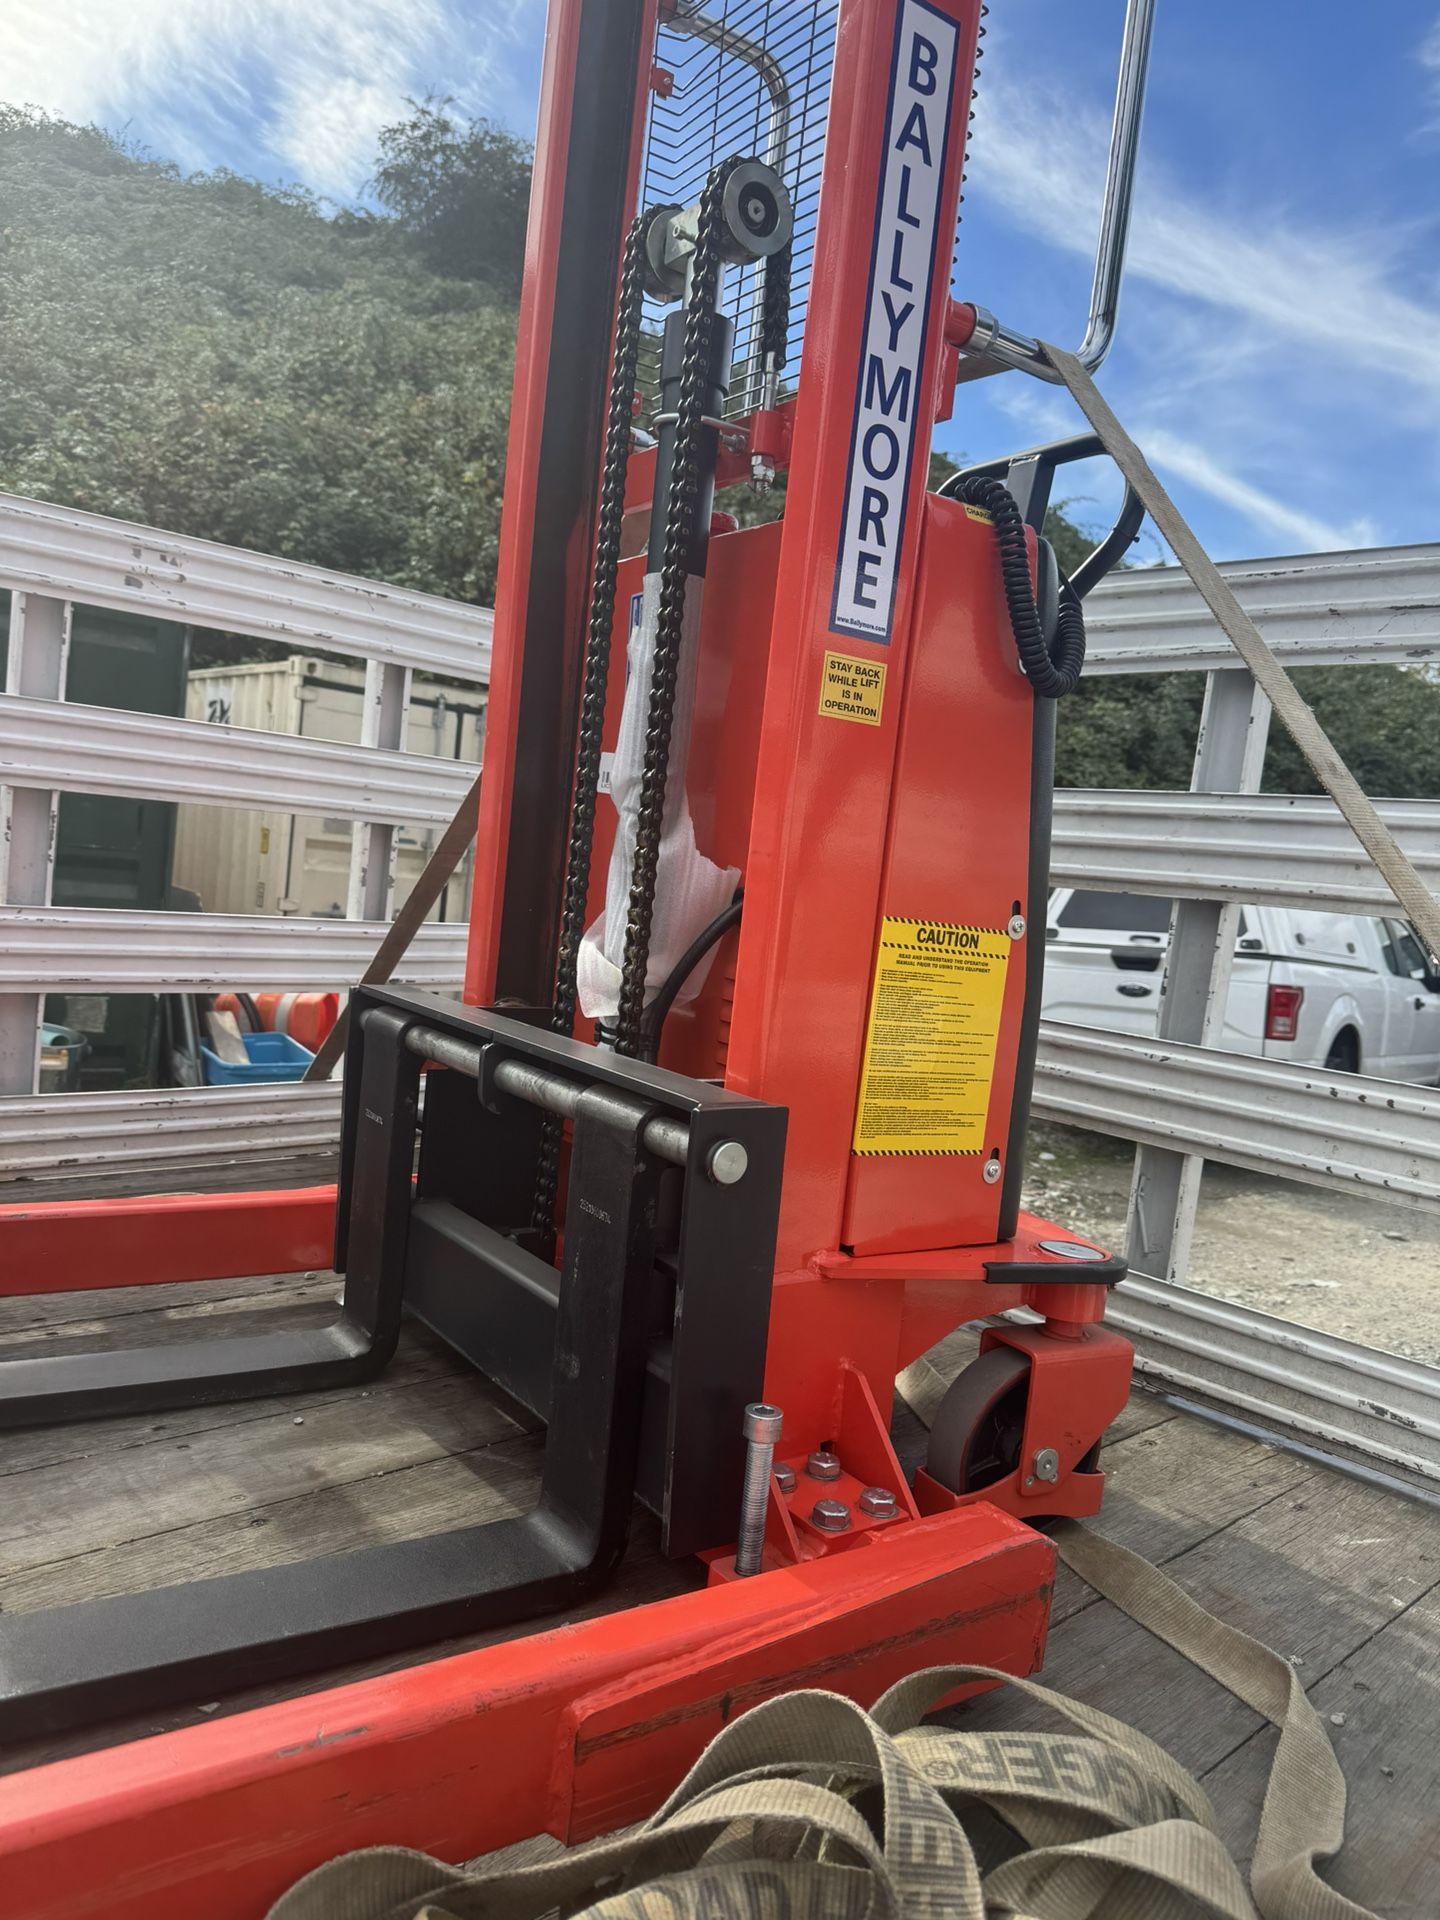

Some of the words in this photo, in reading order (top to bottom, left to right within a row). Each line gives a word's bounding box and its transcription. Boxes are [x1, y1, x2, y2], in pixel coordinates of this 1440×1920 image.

[853, 32, 939, 610] BALLYMORE
[830, 660, 853, 673] STAY
[855, 665, 881, 680] BACK
[828, 672, 858, 687] WHILE
[860, 677, 880, 689] LIFT
[842, 689, 851, 699] IS
[853, 691, 863, 701] IN
[824, 699, 877, 717] OPERATION
[917, 928, 979, 949] CAUTION
[923, 955, 953, 964] UNDERSTAND
[963, 959, 989, 967] OPERATION
